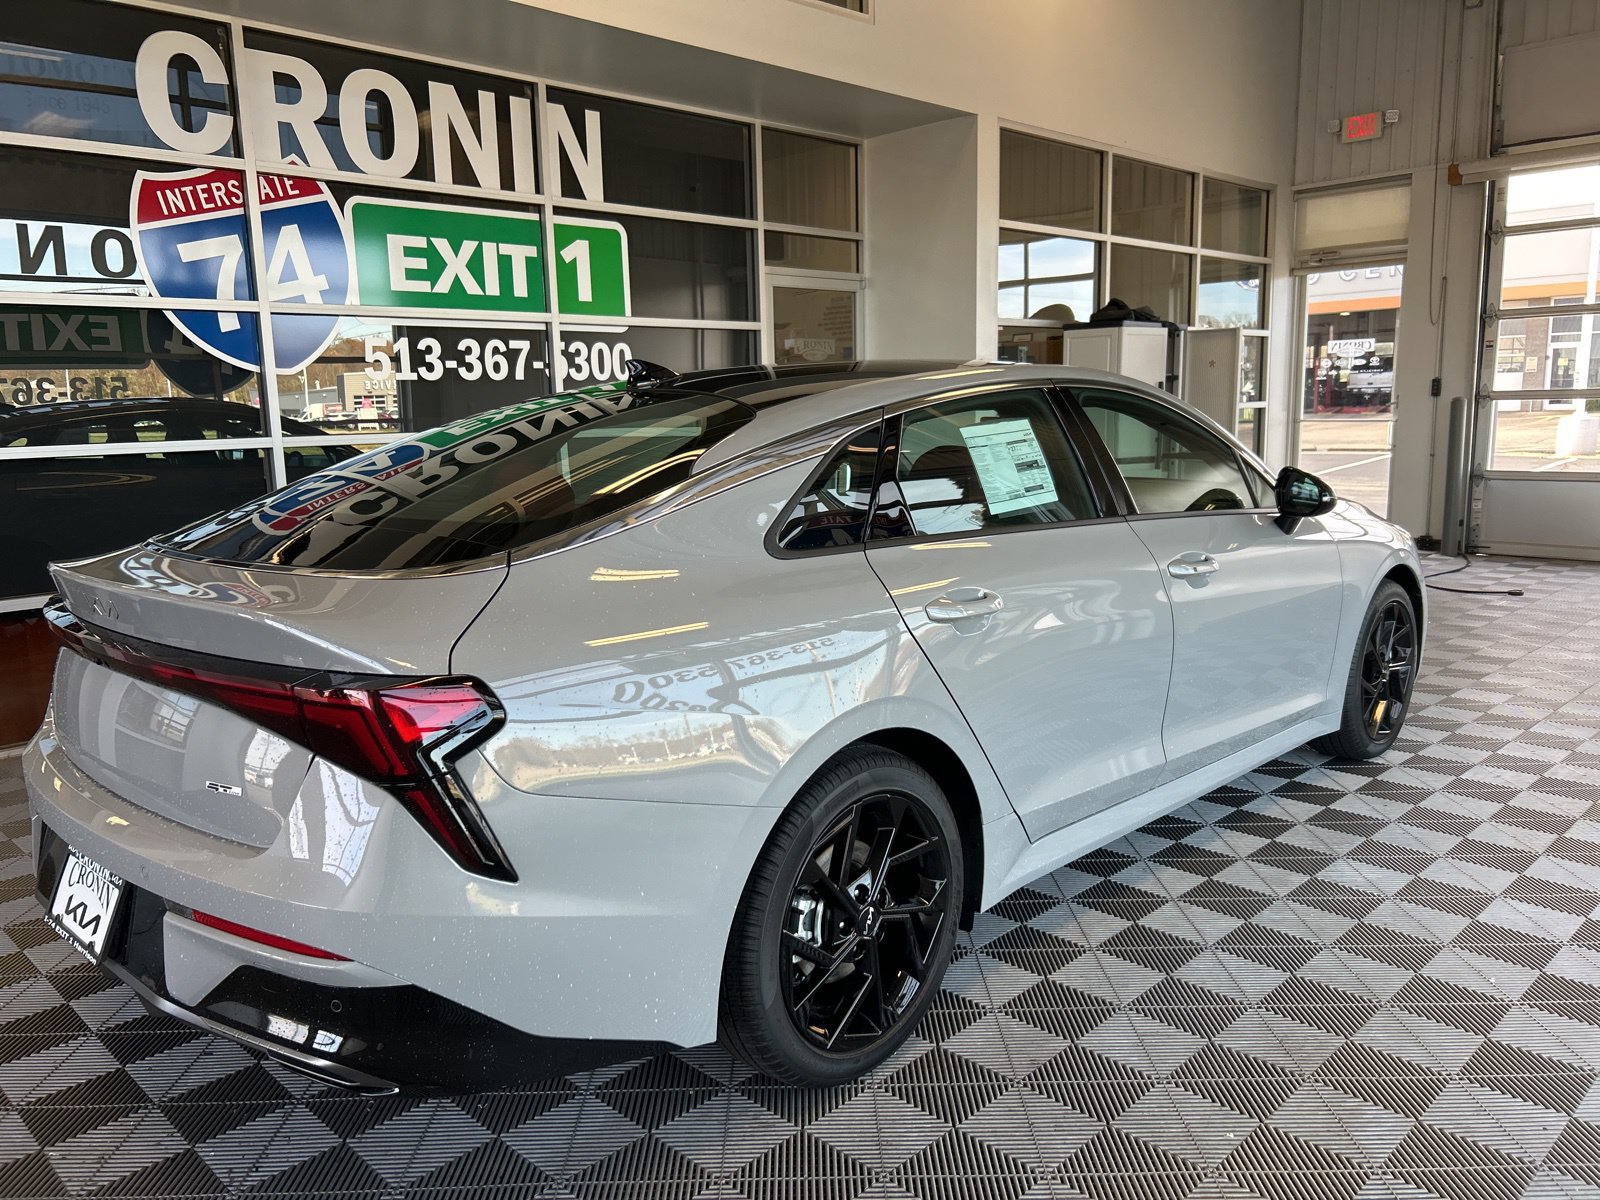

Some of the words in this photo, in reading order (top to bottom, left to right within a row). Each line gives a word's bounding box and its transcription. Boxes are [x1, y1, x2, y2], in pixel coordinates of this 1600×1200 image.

[135, 30, 604, 203] CRONIN
[1347, 113, 1377, 138] EXIT
[156, 175, 300, 215] INTERSATE
[176, 223, 330, 333] 74
[386, 233, 538, 298] EXIT
[559, 239, 593, 302] 1
[68, 861, 115, 915] CRONIN
[43, 915, 56, 929] I-74
[55, 927, 70, 941] EXIT
[73, 940, 98, 966] Harrison
[64, 894, 102, 937] KIA
